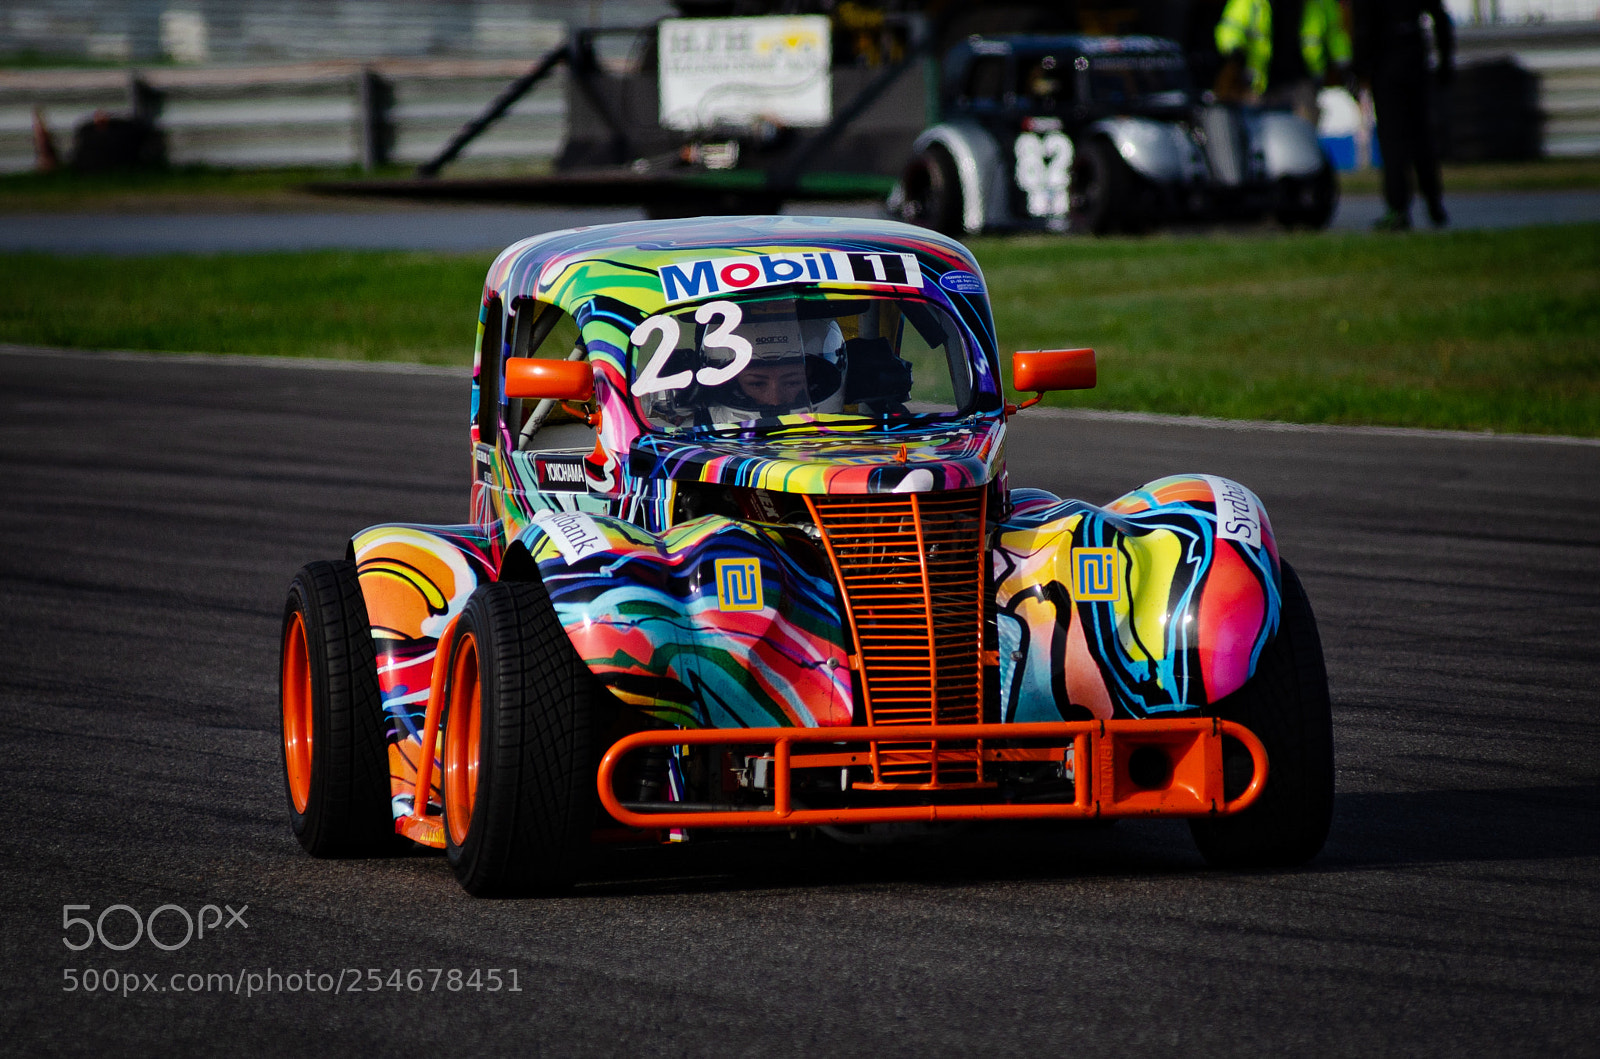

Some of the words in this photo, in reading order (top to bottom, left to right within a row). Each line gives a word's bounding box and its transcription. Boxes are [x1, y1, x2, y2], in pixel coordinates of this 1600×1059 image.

[660, 253, 838, 301] Mobil
[863, 255, 887, 281] 1
[630, 300, 754, 397] 23
[756, 336, 788, 345] sparco
[545, 463, 585, 482] YOKOHAMA
[1221, 479, 1258, 539] Sydba
